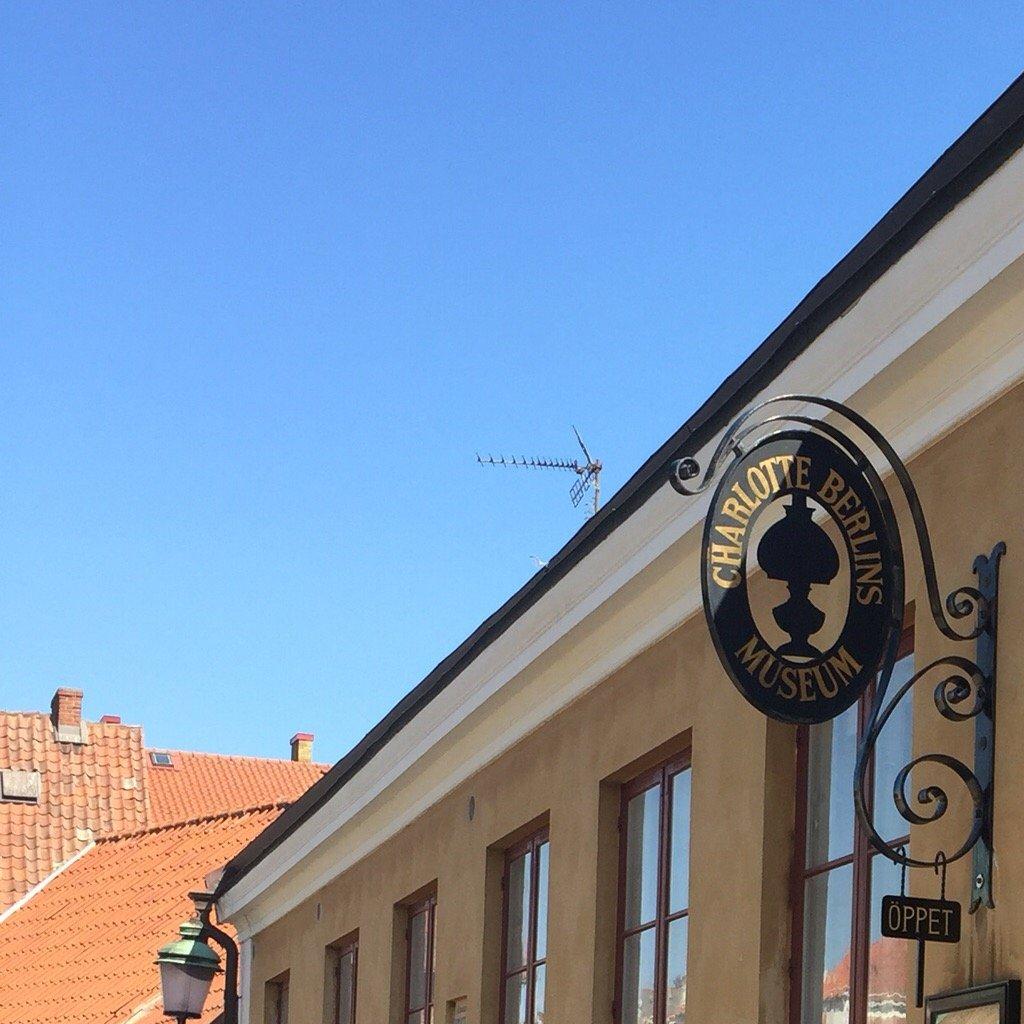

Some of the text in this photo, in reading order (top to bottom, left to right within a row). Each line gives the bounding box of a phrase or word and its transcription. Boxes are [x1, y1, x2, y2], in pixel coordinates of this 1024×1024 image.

[711, 455, 884, 606] CHARLOTTE BERLINS
[733, 634, 864, 702] MUSEUM
[888, 901, 954, 936] ÖPPET
